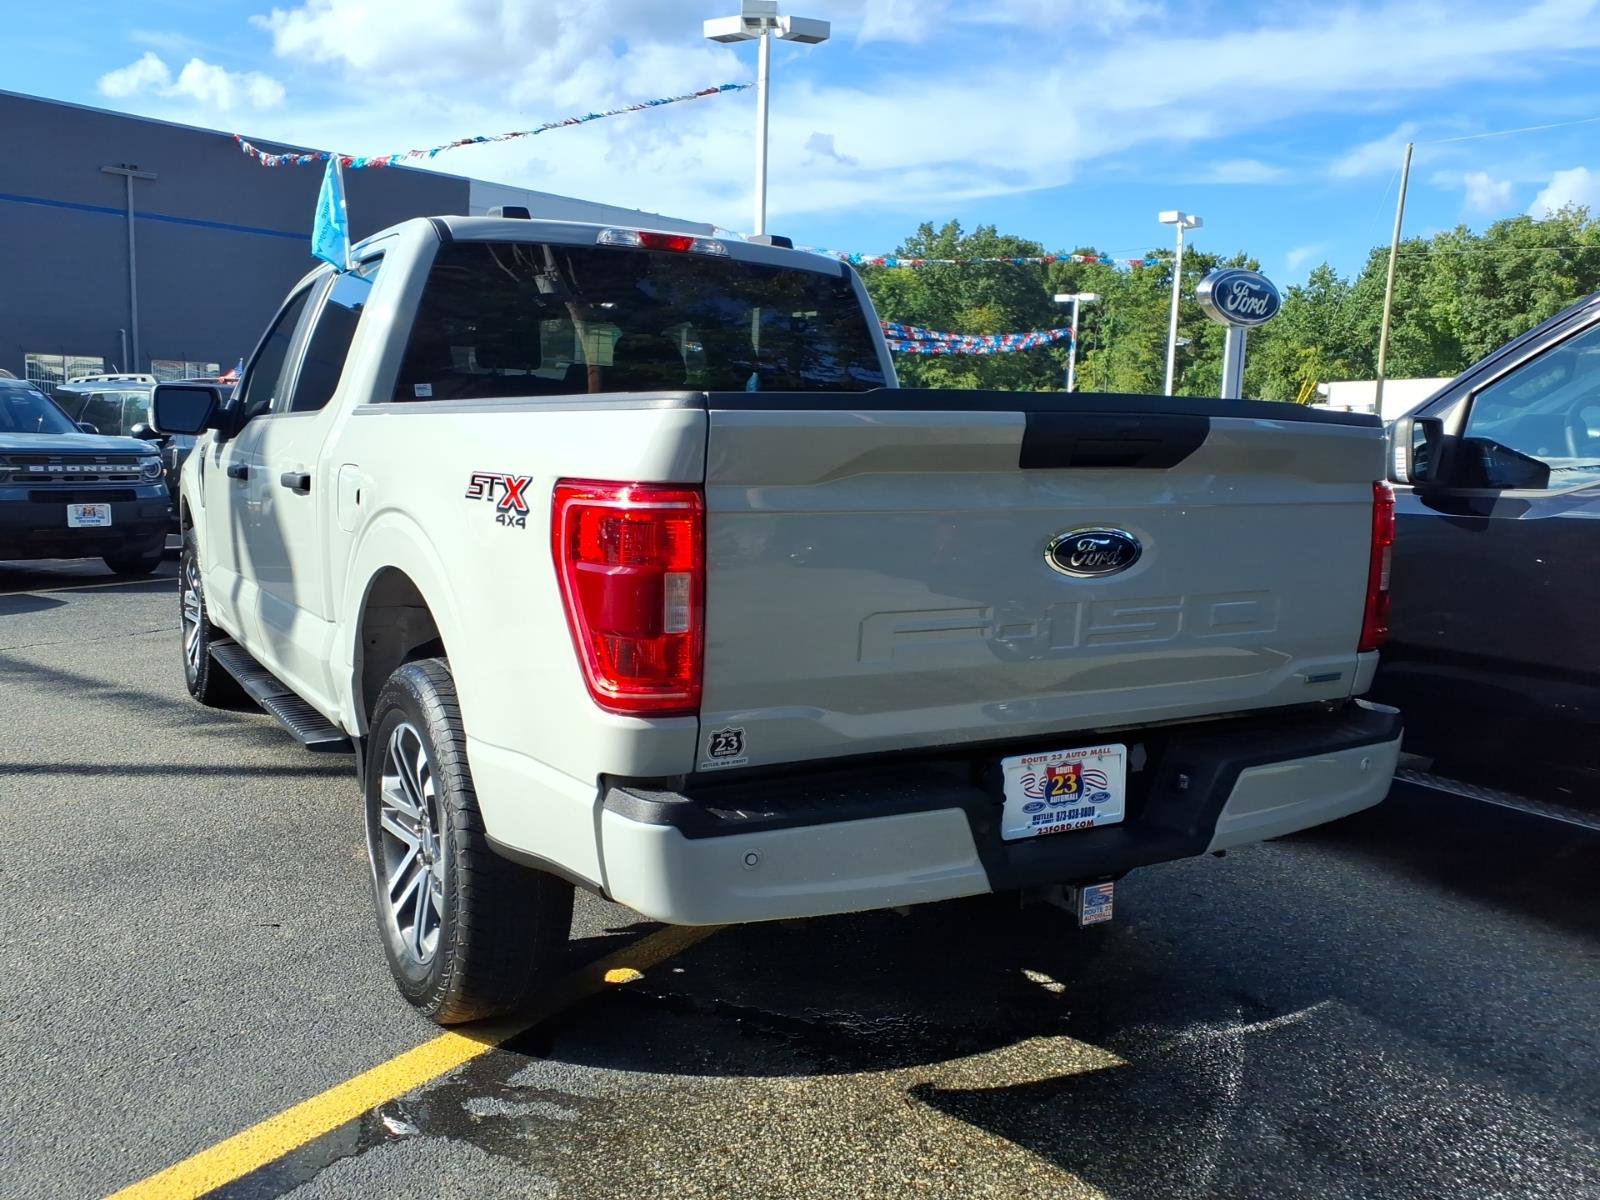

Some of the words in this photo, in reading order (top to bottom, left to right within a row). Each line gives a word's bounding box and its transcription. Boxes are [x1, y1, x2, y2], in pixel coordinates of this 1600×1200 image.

[1227, 280, 1270, 315] Ford
[465, 471, 533, 516] STX
[1070, 538, 1123, 567] Ford
[714, 736, 738, 752] 23
[1021, 755, 1048, 764] ROUTE
[1065, 750, 1087, 759] AUTO
[1090, 748, 1111, 756] MALL
[1055, 766, 1073, 774] ROUTE
[1051, 773, 1078, 796] 23
[1032, 812, 1054, 822] BUTLER
[1036, 820, 1095, 835] 23FORD.COM
